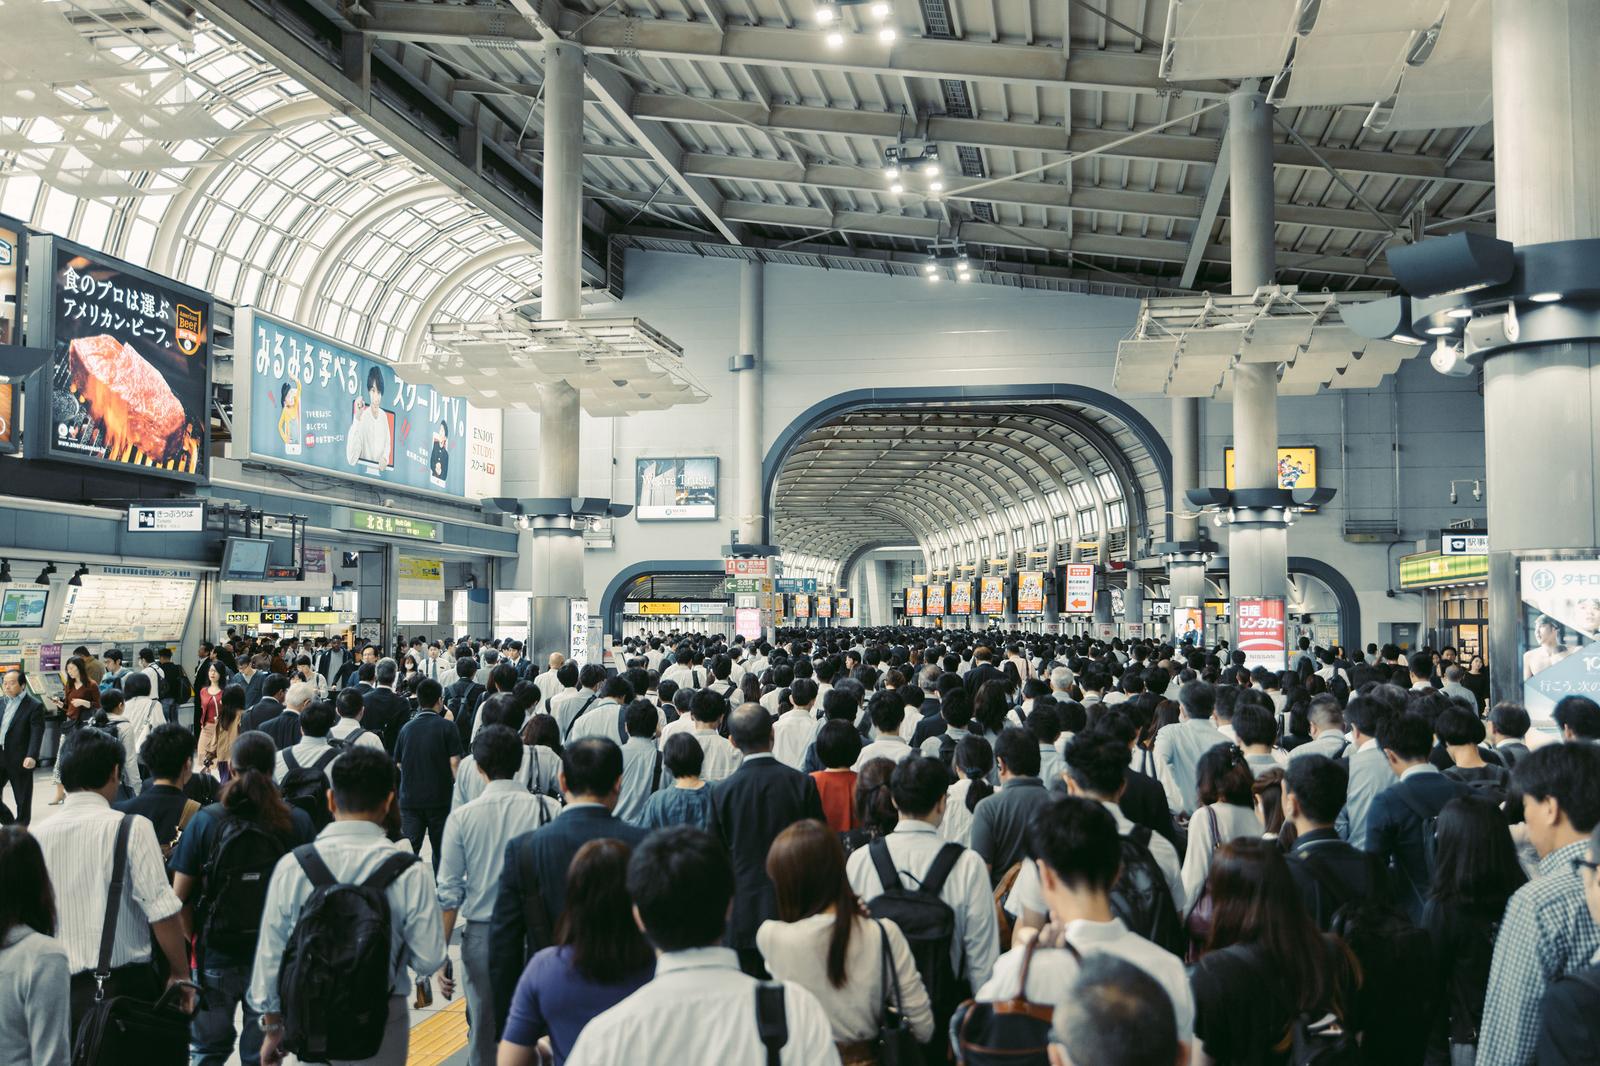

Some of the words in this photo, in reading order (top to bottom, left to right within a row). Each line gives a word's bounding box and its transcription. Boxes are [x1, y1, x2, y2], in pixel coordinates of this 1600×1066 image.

[63, 266, 170, 320] 食のプロは選ぶ
[63, 297, 169, 349] アメリカン・ビーフ。
[179, 317, 197, 332] Beef
[473, 427, 495, 444] ENJOY
[156, 510, 193, 518] きっぷうりば
[367, 514, 393, 532] 北改札
[1467, 538, 1488, 547] 駅事
[264, 613, 294, 621] KIOSK
[1239, 605, 1261, 617] 日産
[1239, 616, 1284, 629] レンタカー
